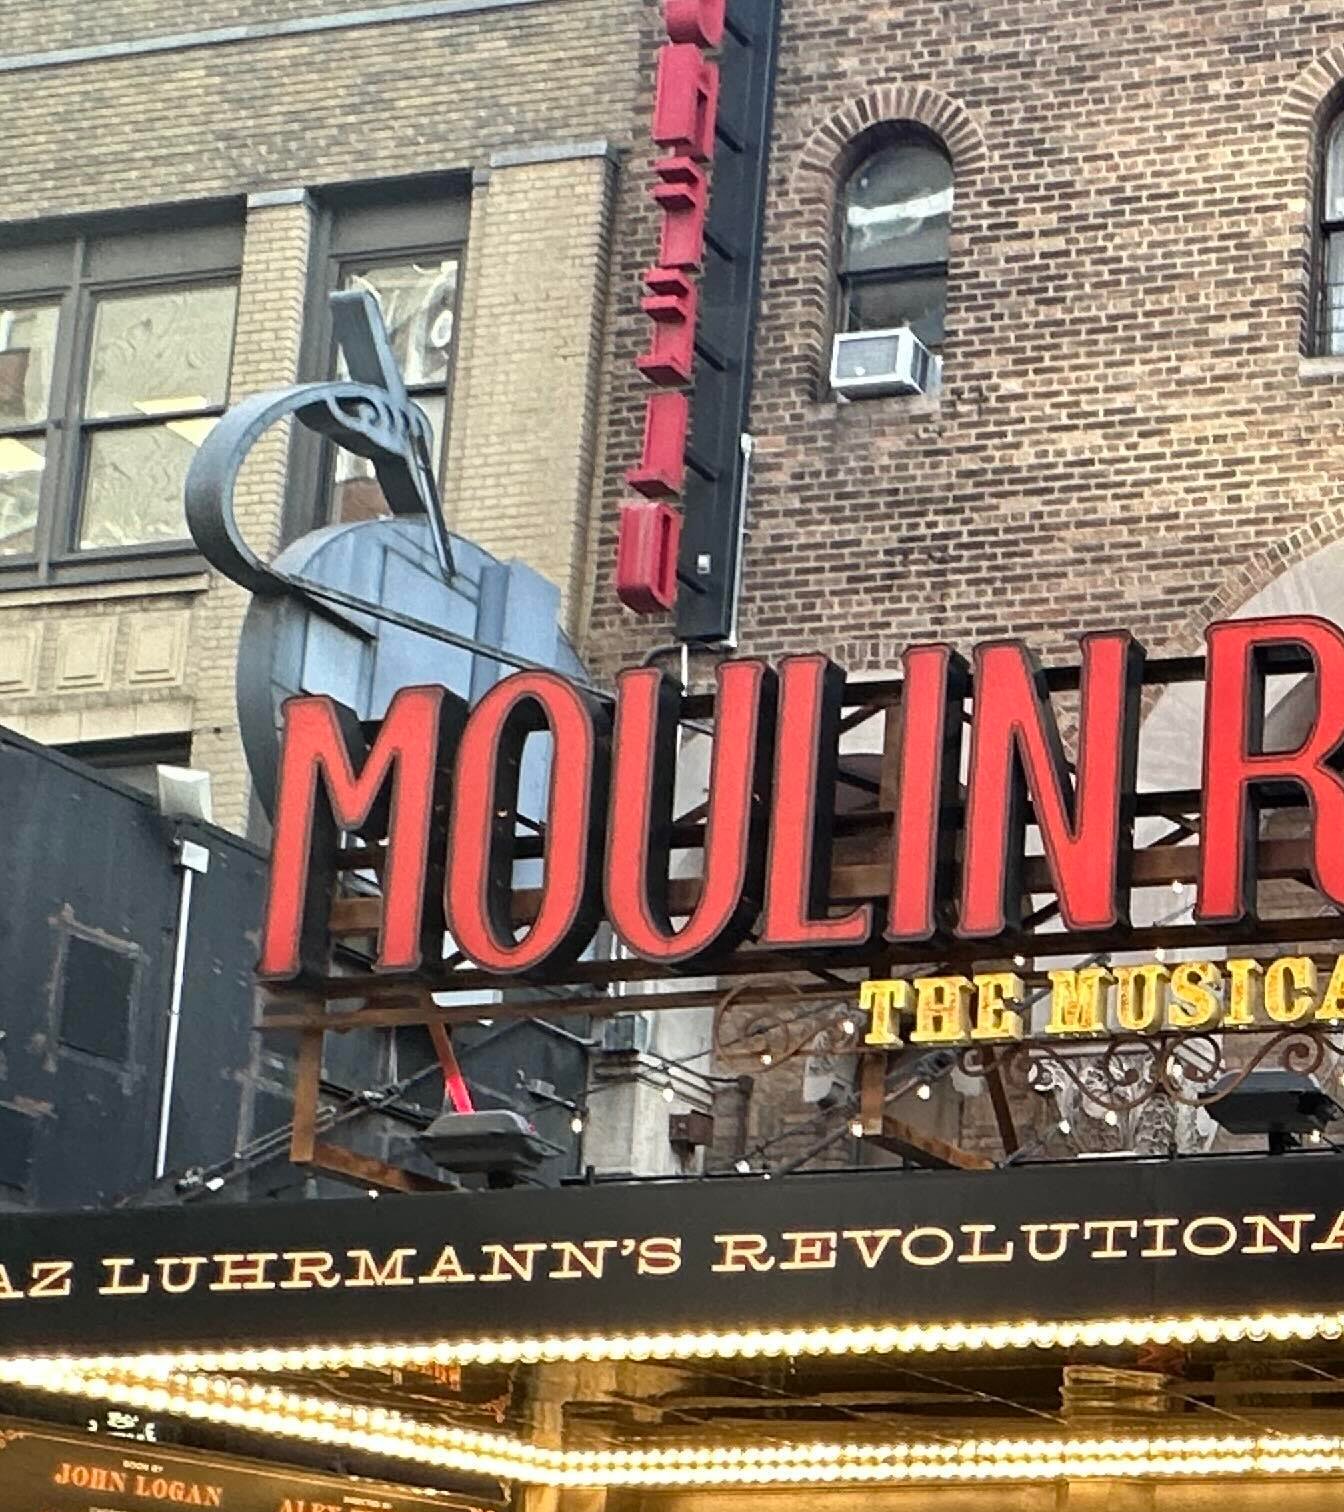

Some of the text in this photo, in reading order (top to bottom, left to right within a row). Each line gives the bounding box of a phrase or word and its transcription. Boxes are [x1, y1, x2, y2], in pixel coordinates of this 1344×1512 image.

[258, 631, 1134, 978] MOULIN
[860, 973, 1023, 1045] THE
[98, 1235, 683, 1296] LUHRMANN'S
[54, 1462, 224, 1508] JOHN LOGAN
